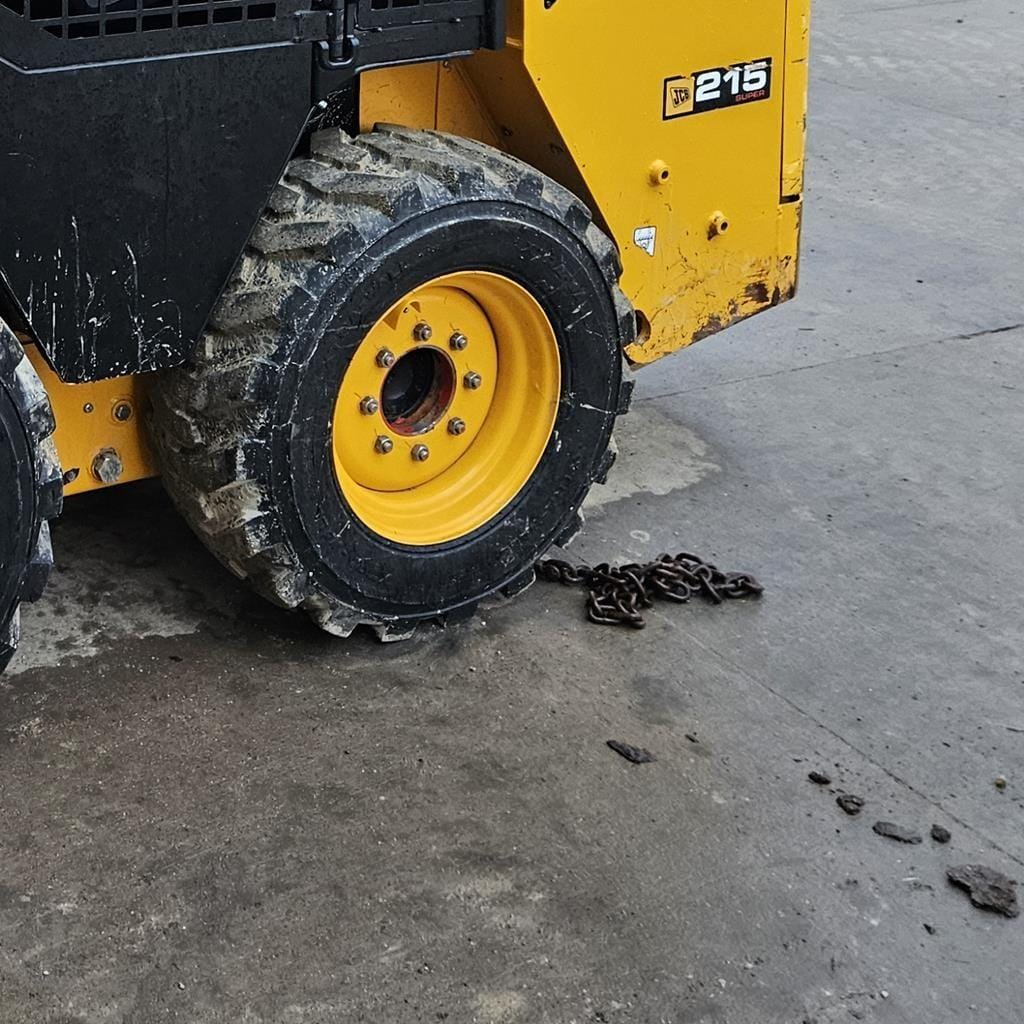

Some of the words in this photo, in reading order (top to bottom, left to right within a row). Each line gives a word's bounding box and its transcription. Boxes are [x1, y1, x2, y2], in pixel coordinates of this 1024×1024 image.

[696, 61, 767, 102] 215
[673, 87, 690, 105] JCB
[735, 89, 765, 101] SUPER
